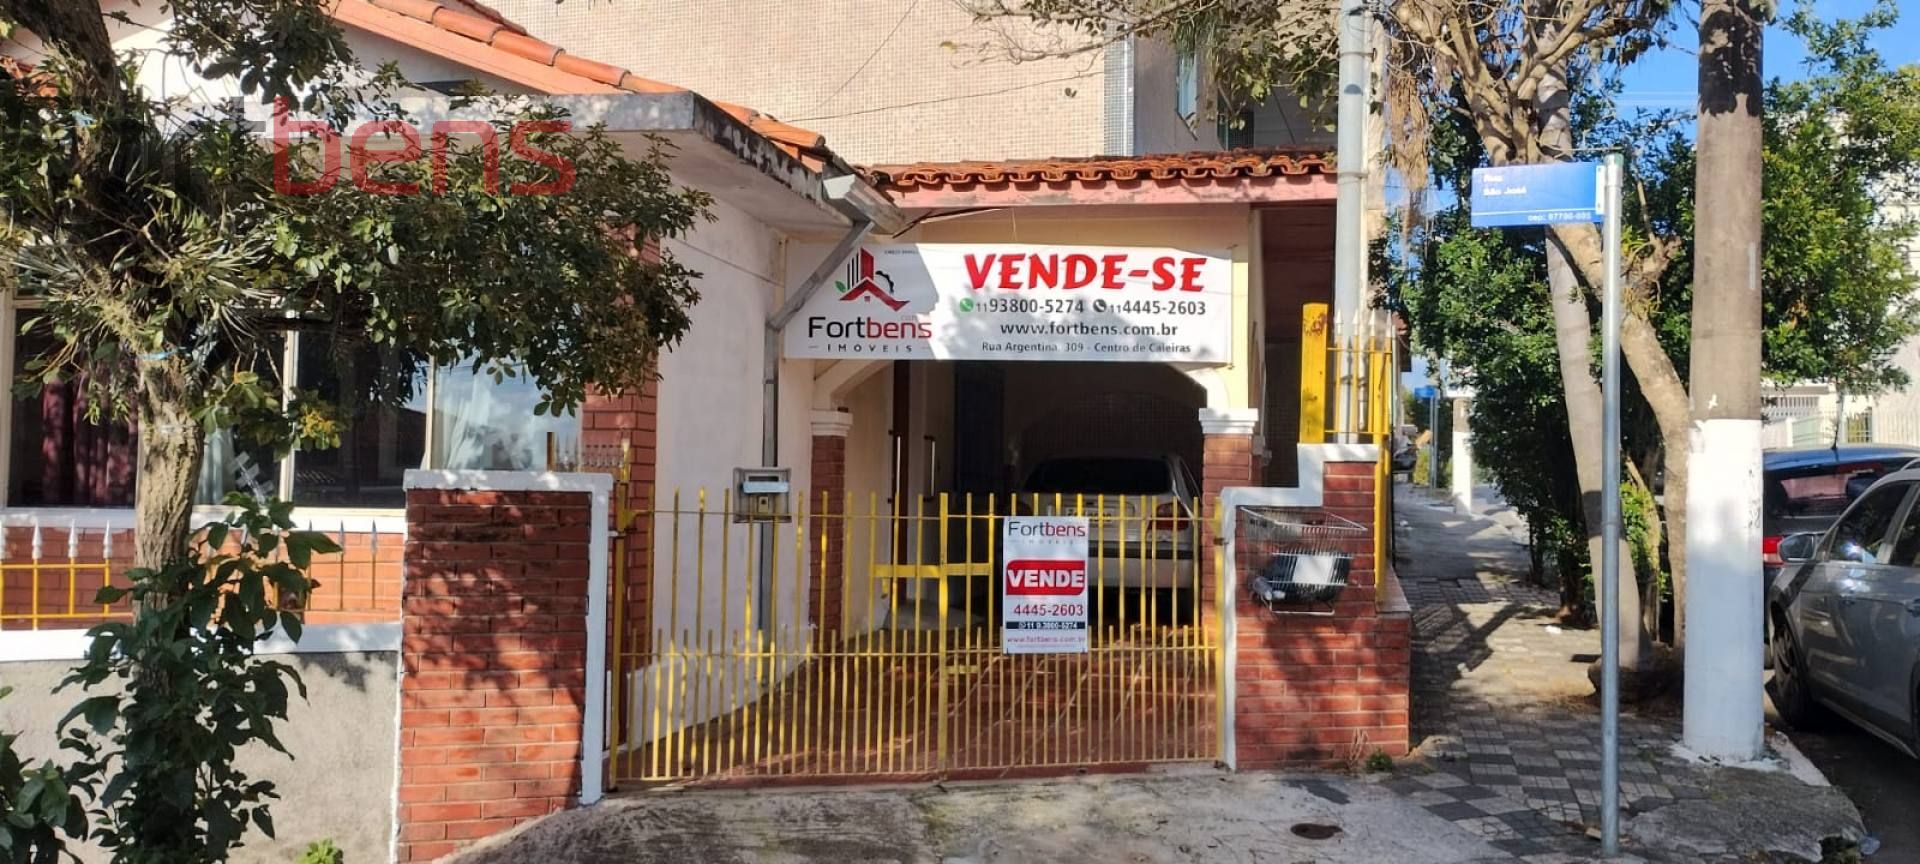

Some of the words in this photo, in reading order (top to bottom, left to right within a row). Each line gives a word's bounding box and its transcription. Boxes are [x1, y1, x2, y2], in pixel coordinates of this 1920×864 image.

[964, 253, 1207, 292] VENDE-SE
[808, 316, 932, 339] Fortbens
[1000, 322, 1178, 337] www.fortbens.com.br
[982, 342, 1002, 352] Rua
[1066, 342, 1084, 352] 309
[1095, 343, 1130, 353] Centro
[1133, 343, 1146, 353] de
[1009, 521, 1086, 537] Fortbens
[1007, 569, 1084, 588] VENDE
[1014, 604, 1083, 617] 4445-2603
